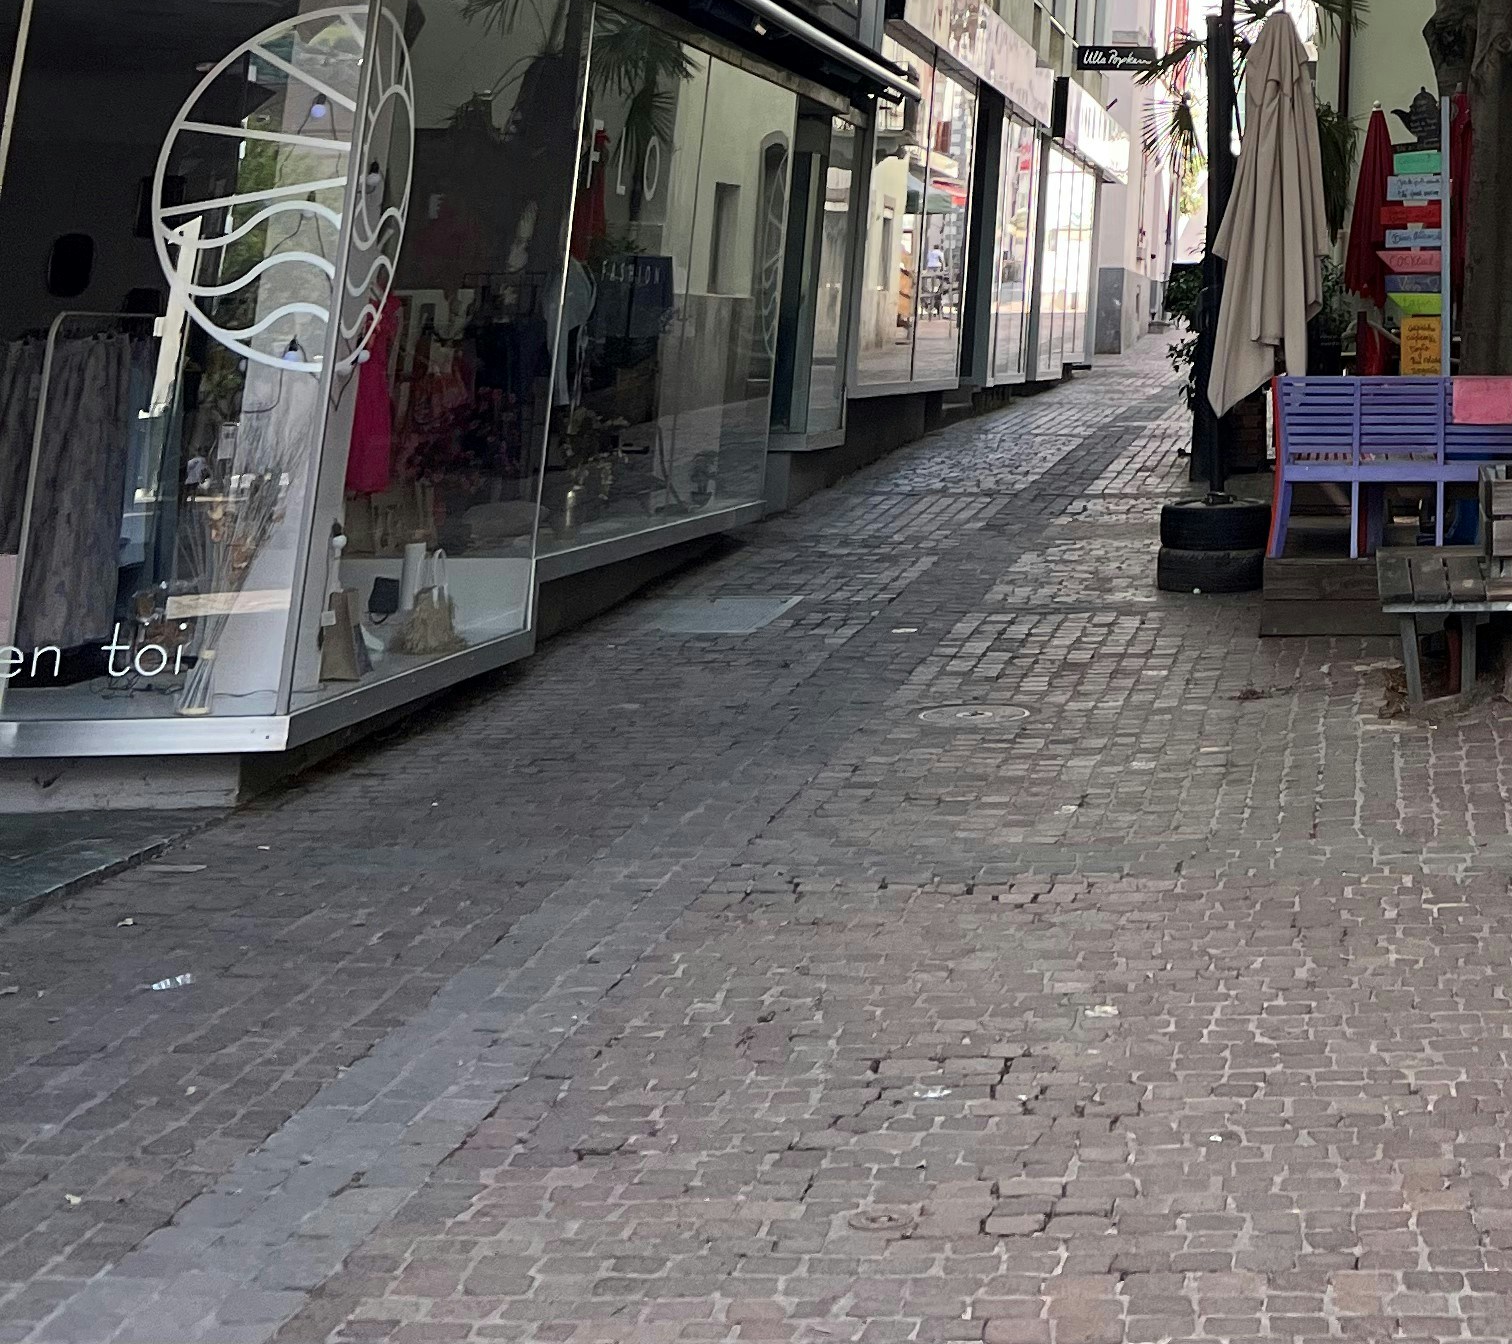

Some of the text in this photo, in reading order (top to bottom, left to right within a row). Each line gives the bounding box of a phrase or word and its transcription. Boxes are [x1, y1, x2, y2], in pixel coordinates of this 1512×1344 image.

[1083, 49, 1106, 64] Ulla
[601, 259, 661, 285] FASHION
[101, 622, 187, 677] toi
